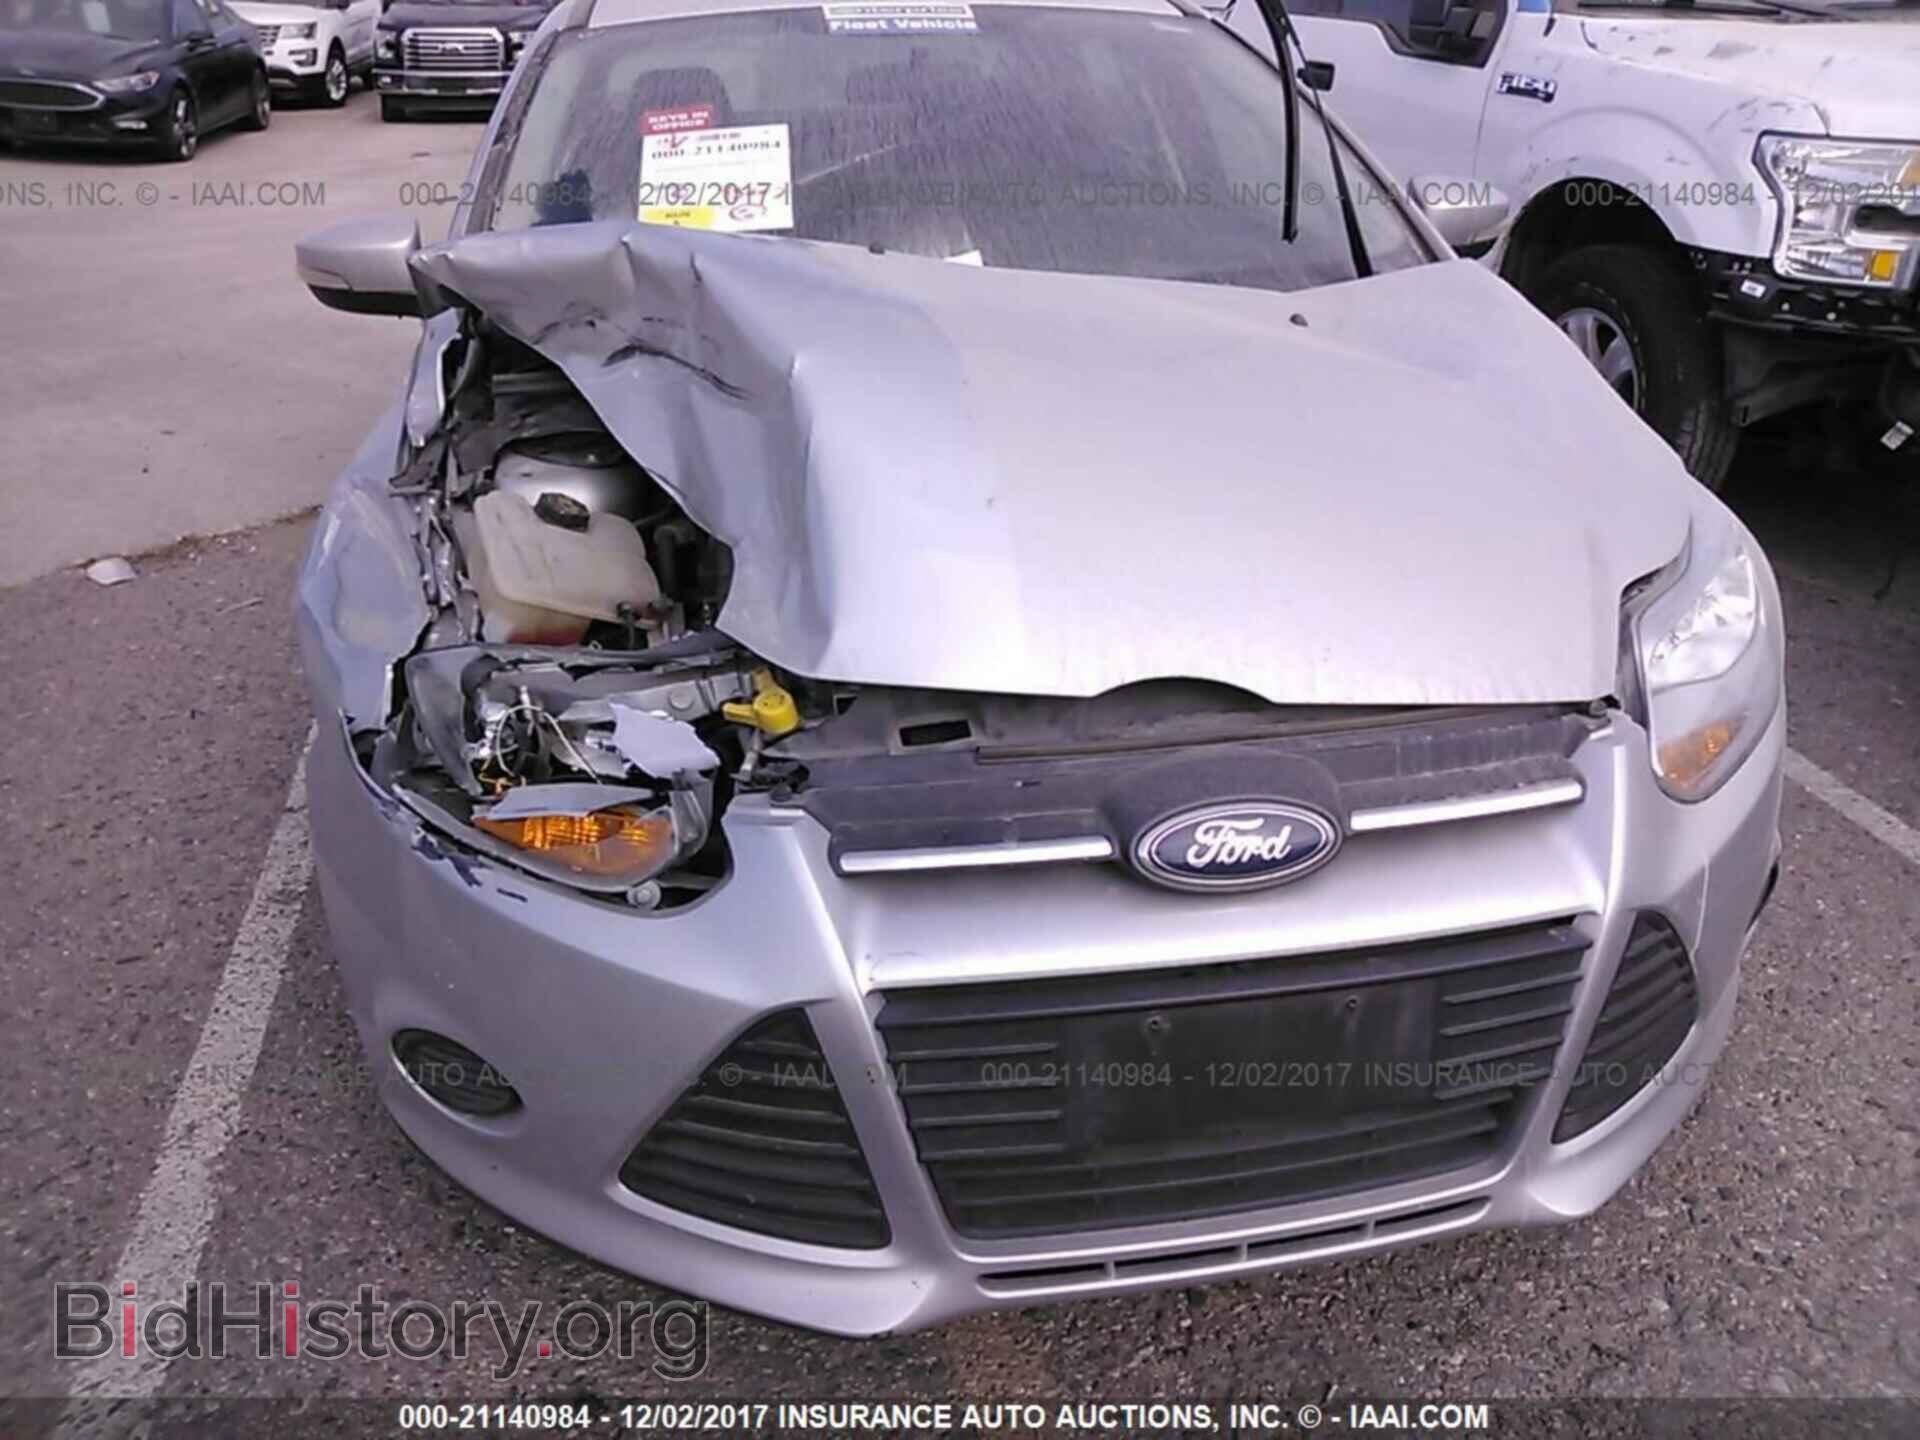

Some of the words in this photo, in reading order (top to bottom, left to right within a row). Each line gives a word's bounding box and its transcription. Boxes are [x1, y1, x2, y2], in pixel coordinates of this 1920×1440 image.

[830, 19, 888, 31] Fleet
[895, 18, 977, 31] Vehicle
[1186, 817, 1293, 868] Ford
